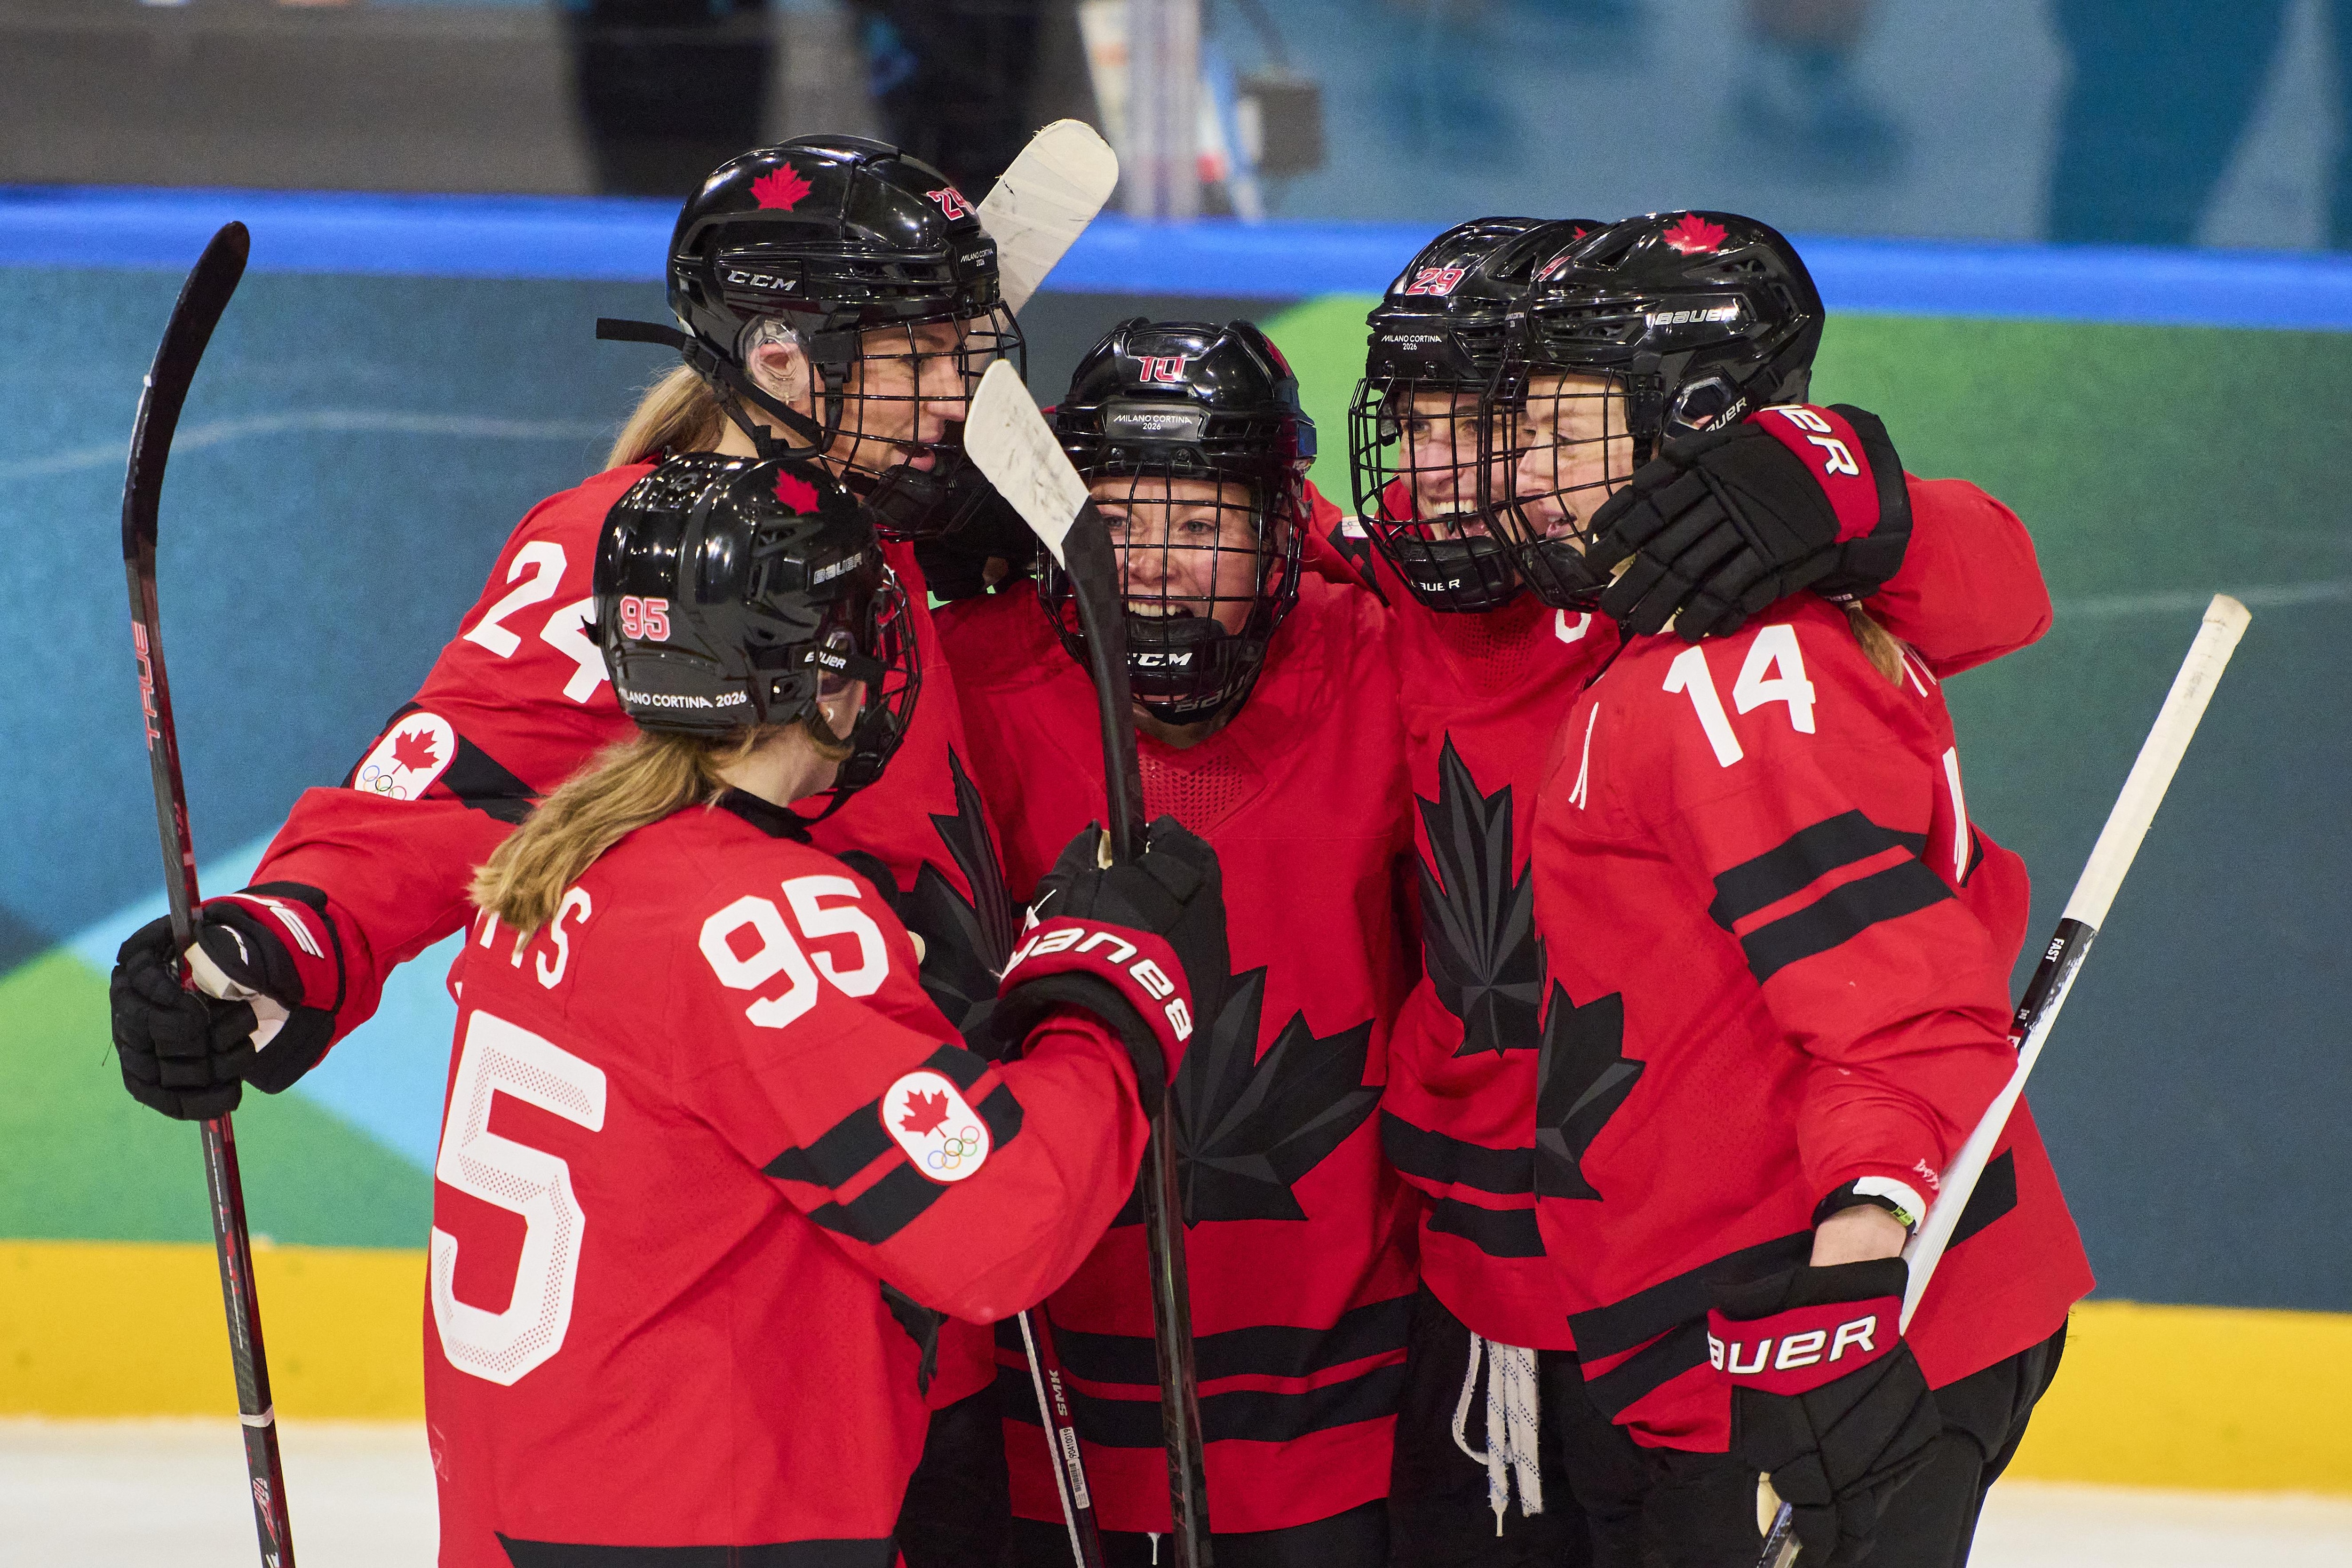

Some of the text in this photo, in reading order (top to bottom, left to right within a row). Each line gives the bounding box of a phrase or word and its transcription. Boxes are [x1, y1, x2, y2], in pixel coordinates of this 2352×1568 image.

[727, 270, 797, 291] CCM
[1406, 267, 1465, 296] 29
[1655, 308, 1737, 326] BAUER
[1137, 355, 1186, 383] 10
[1113, 414, 1193, 424] MILANO CORTINA
[462, 541, 610, 703] 24
[620, 595, 671, 641] 95
[652, 693, 714, 708] CORTINA
[715, 690, 747, 708] 2026
[1662, 624, 1816, 768] 14
[699, 875, 890, 1029] 95
[2045, 937, 2065, 963] FAST
[1048, 1369, 1068, 1417] SMK
